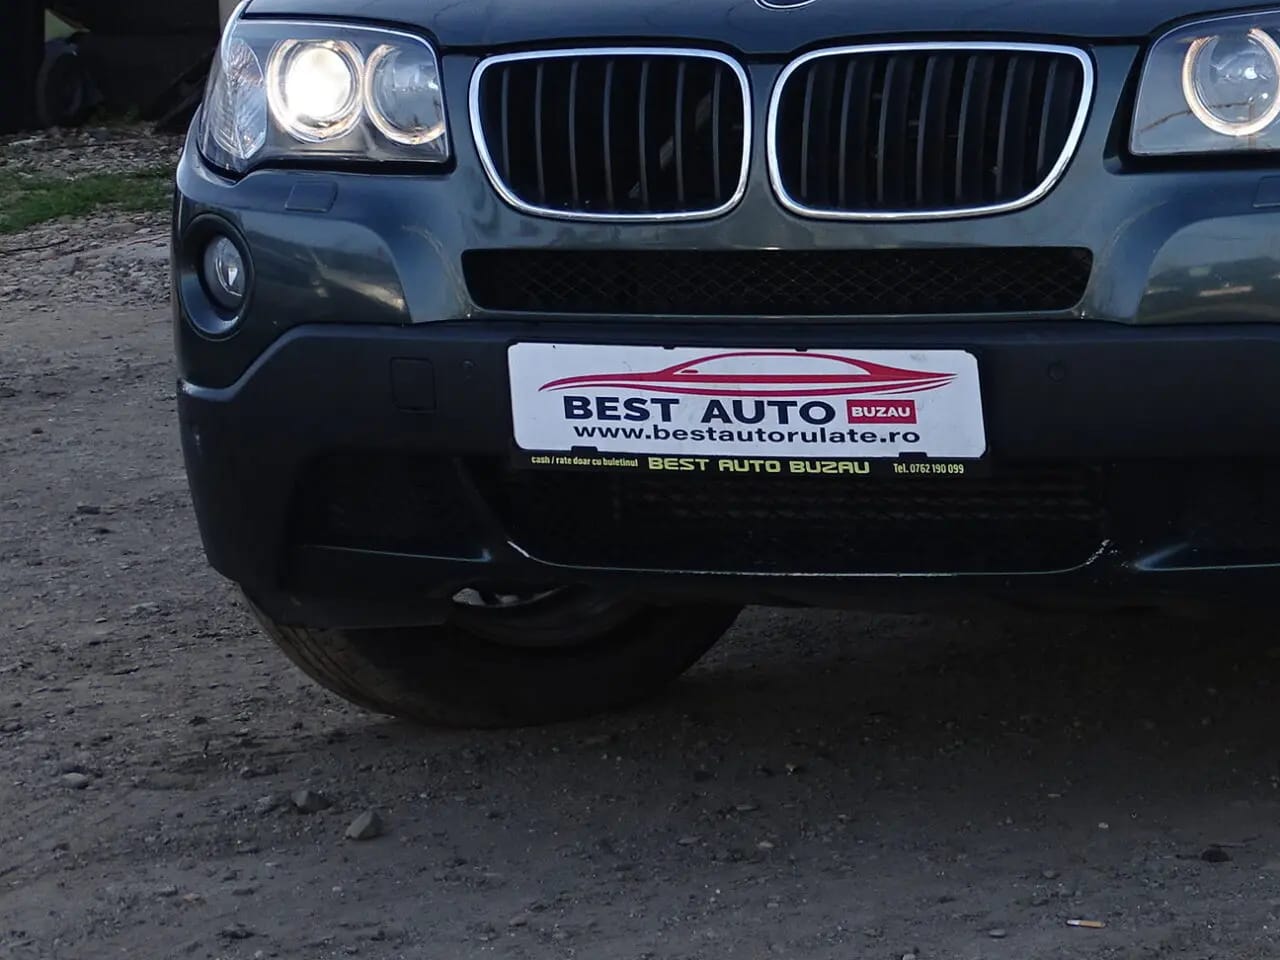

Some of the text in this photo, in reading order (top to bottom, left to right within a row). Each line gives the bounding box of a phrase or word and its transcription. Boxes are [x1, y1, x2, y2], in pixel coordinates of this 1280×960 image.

[563, 395, 911, 425] BEST AUTO BUZAU
[573, 424, 921, 444] www.bestautorulate.ro
[531, 455, 551, 465] cash
[556, 456, 573, 465] rate
[573, 456, 591, 466] doar
[602, 457, 639, 468] buletinul
[648, 456, 710, 471] BEST
[718, 458, 780, 473] AUTO
[789, 460, 870, 474] BUZAU
[893, 462, 910, 474] Tel.
[909, 463, 931, 474] 0762
[931, 463, 947, 474] 190
[947, 464, 965, 475] 099
